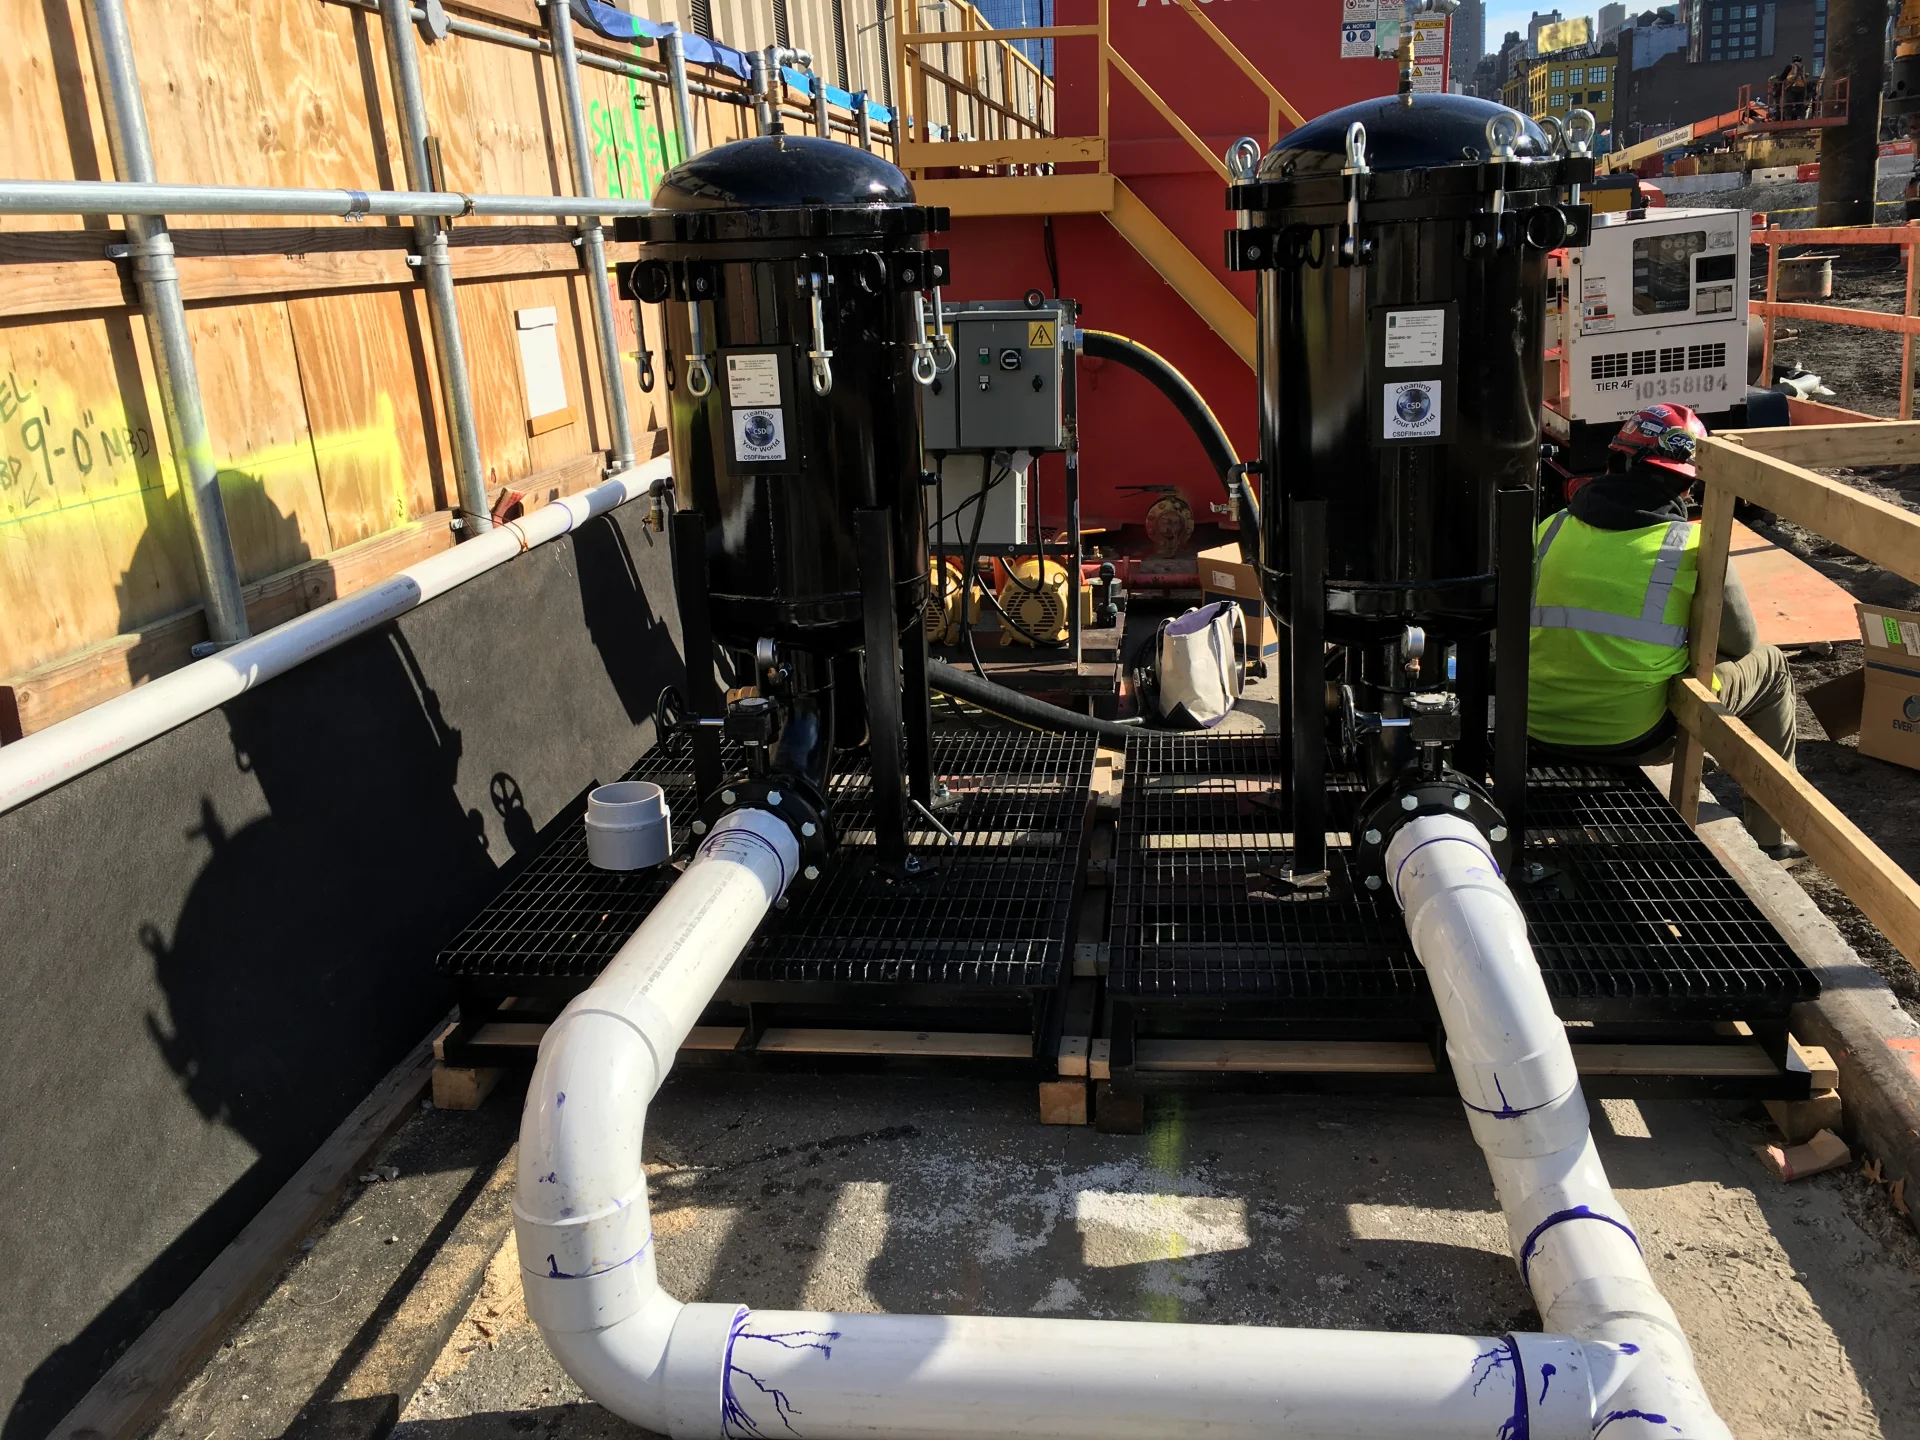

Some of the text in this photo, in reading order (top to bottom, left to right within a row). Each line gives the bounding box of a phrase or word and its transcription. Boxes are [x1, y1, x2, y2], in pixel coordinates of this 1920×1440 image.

[1395, 382, 1432, 395] Cleaning
[1595, 379, 1634, 392] TIER 4F
[1635, 373, 1728, 401] 10358184
[742, 410, 774, 420] Cleaning
[1392, 413, 1436, 428] Your World
[753, 427, 767, 435] CSD
[1392, 430, 1436, 438] CSDFilters.com
[742, 438, 781, 452] Your World
